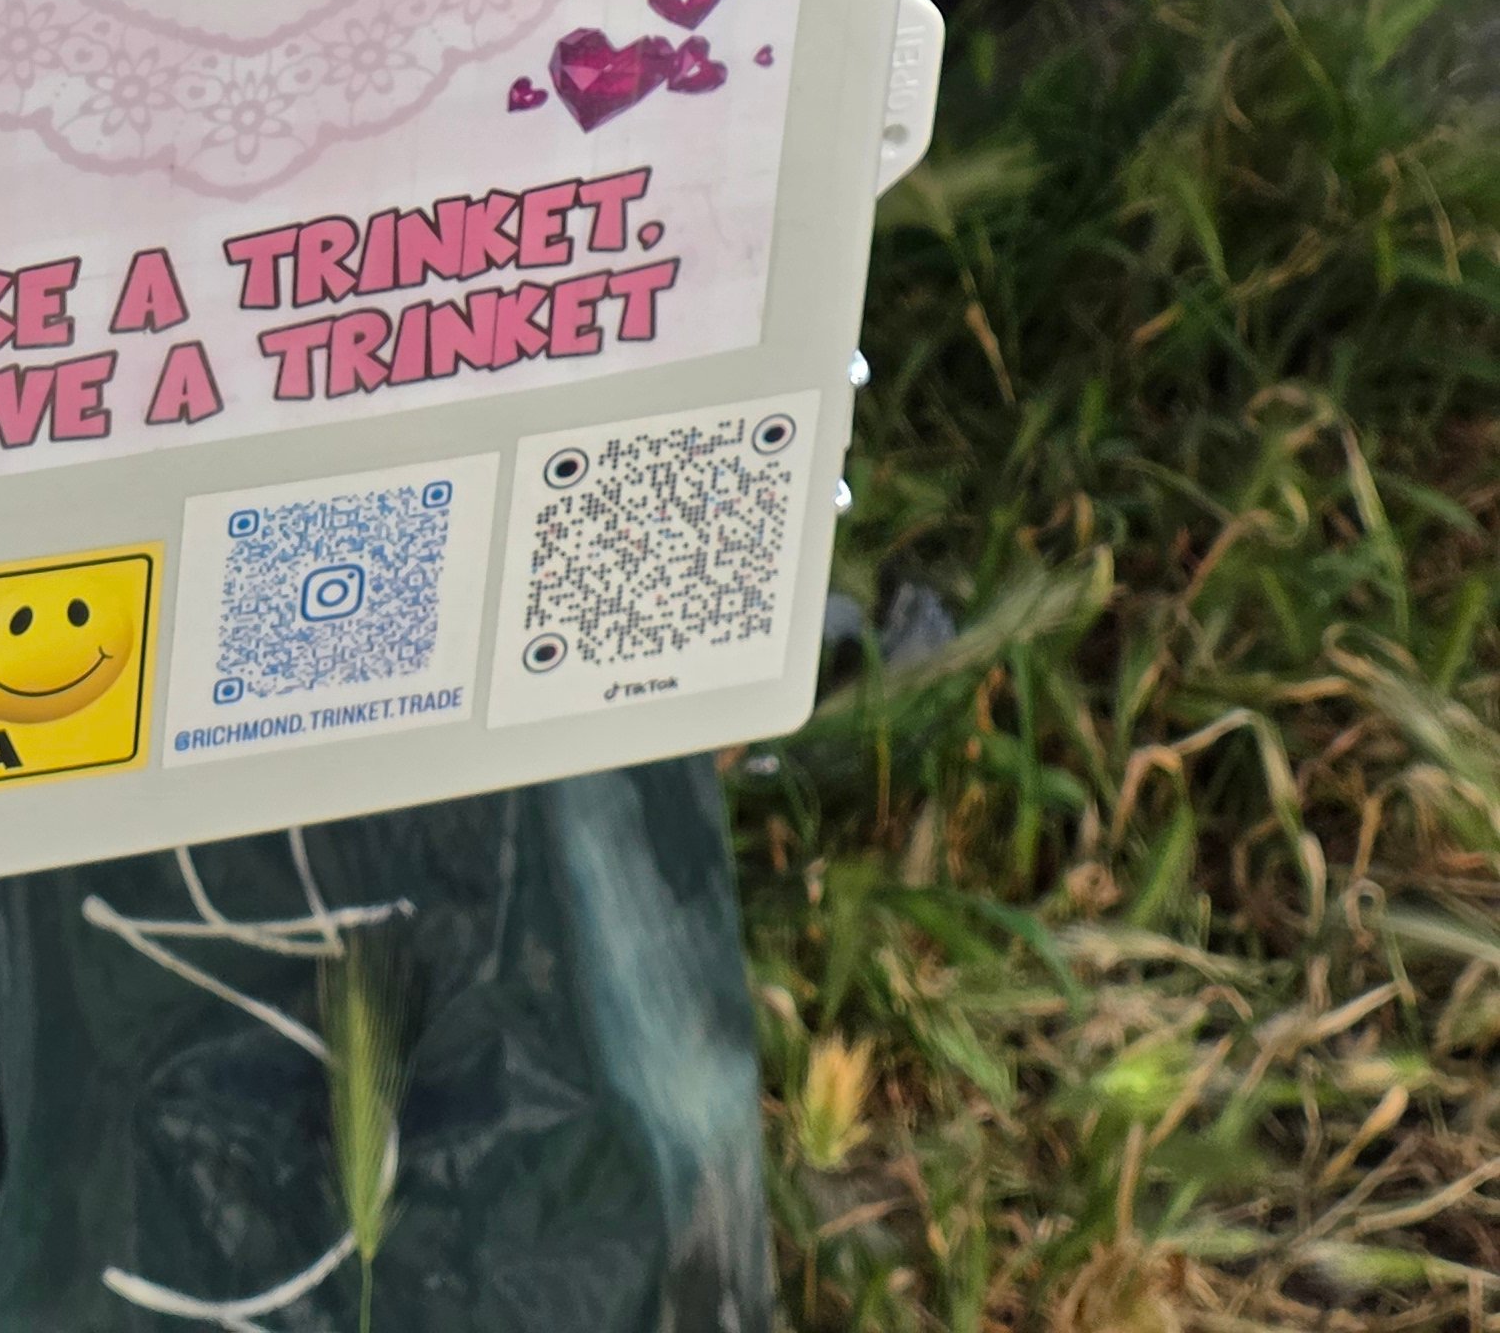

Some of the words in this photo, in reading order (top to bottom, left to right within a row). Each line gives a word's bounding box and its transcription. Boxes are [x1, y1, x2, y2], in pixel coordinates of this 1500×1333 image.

[109, 247, 190, 334] A
[145, 340, 224, 427] A
[258, 257, 681, 401] TRINKET
[622, 676, 679, 698] TikTok
